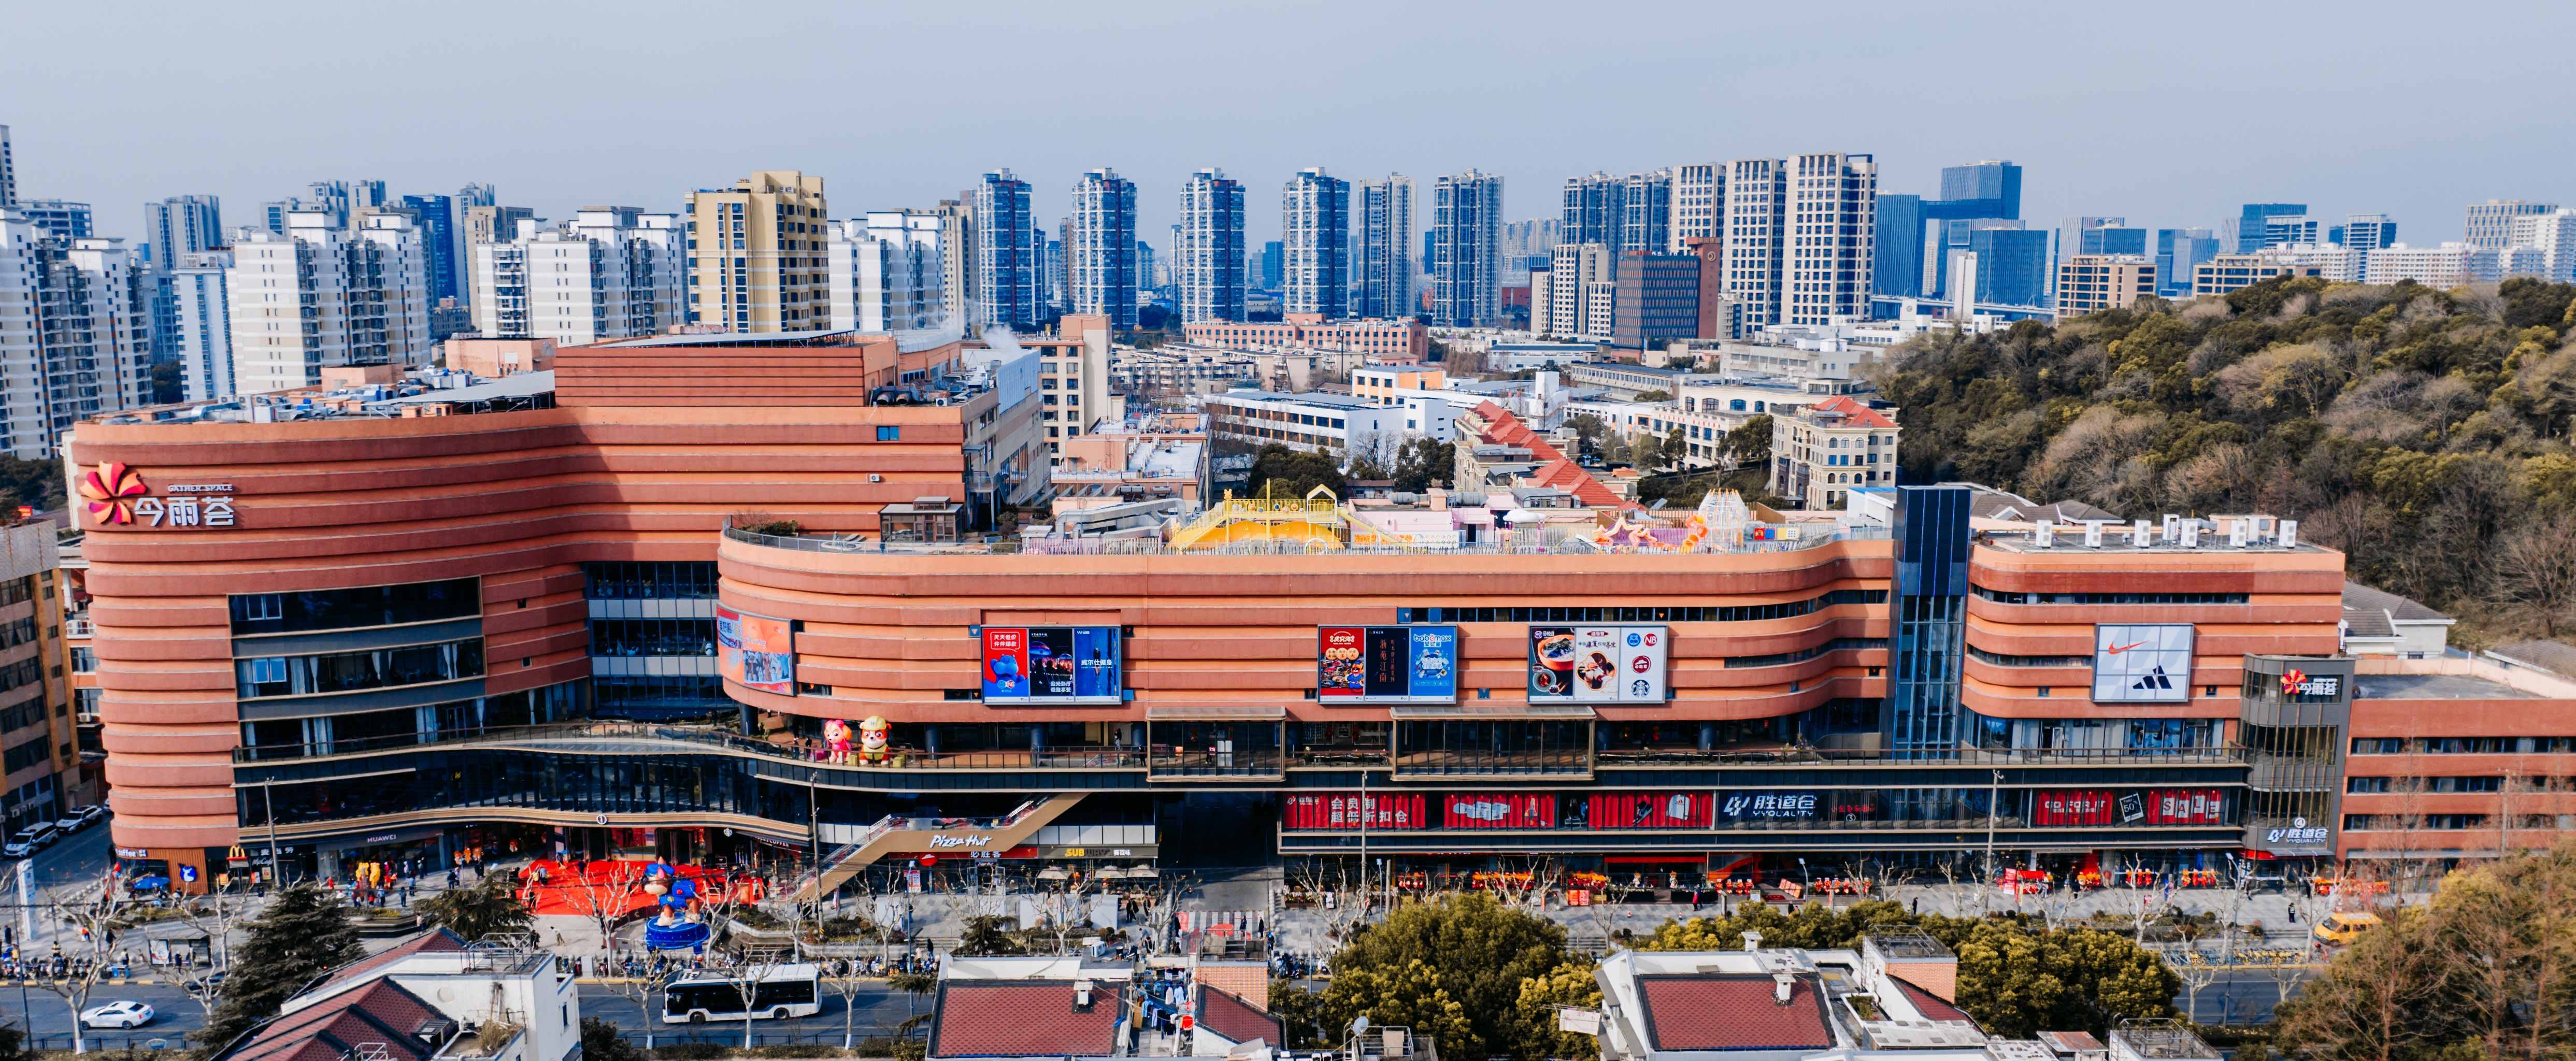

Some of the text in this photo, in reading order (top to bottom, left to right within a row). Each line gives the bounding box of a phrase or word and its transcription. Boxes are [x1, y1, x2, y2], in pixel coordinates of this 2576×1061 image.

[135, 496, 234, 526] 今雨荟
[1414, 633, 1451, 642] babemax
[1644, 636, 1657, 644] NB
[2300, 683, 2337, 695] 今雨荟
[1331, 797, 1375, 810] 会员制
[1754, 795, 1817, 809] 胜道仓
[2163, 797, 2216, 814] SALE
[1331, 810, 1407, 823] 超低折扣仓
[367, 834, 396, 843] HUAWEI
[2287, 828, 2329, 838] 胜道仓
[929, 835, 992, 848] Pizza Hut
[1065, 848, 1110, 857] SUBWAY
